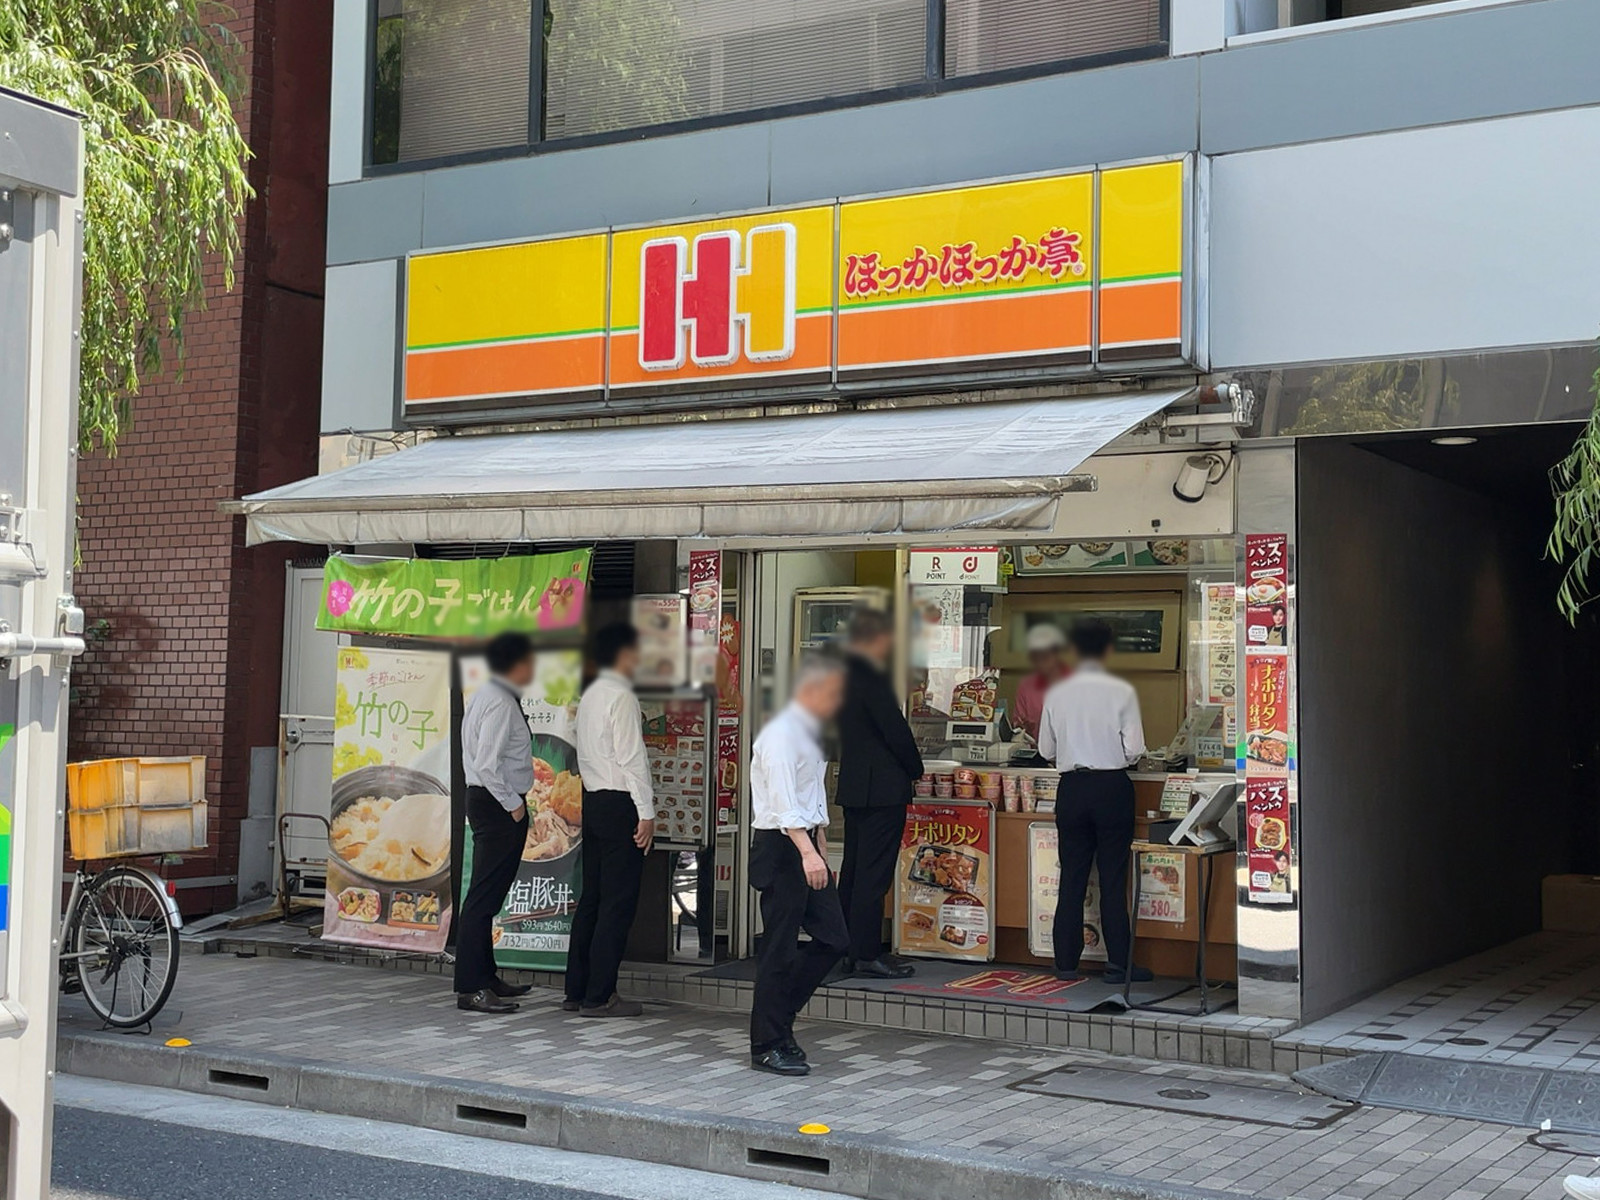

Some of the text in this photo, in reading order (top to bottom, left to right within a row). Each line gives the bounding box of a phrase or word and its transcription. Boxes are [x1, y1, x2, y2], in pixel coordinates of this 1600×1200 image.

[845, 229, 1083, 298] ほっかほっか亭
[1249, 541, 1284, 557] バズ
[692, 557, 718, 570] バズ
[1251, 558, 1281, 567] ベントウ
[1261, 664, 1277, 735] ナポリタン
[352, 691, 438, 750] 竹の子
[1250, 785, 1285, 801] バズ
[1252, 801, 1282, 811] ベントウ
[909, 821, 982, 845] ナポリタン
[505, 876, 575, 916] 塩豚丼
